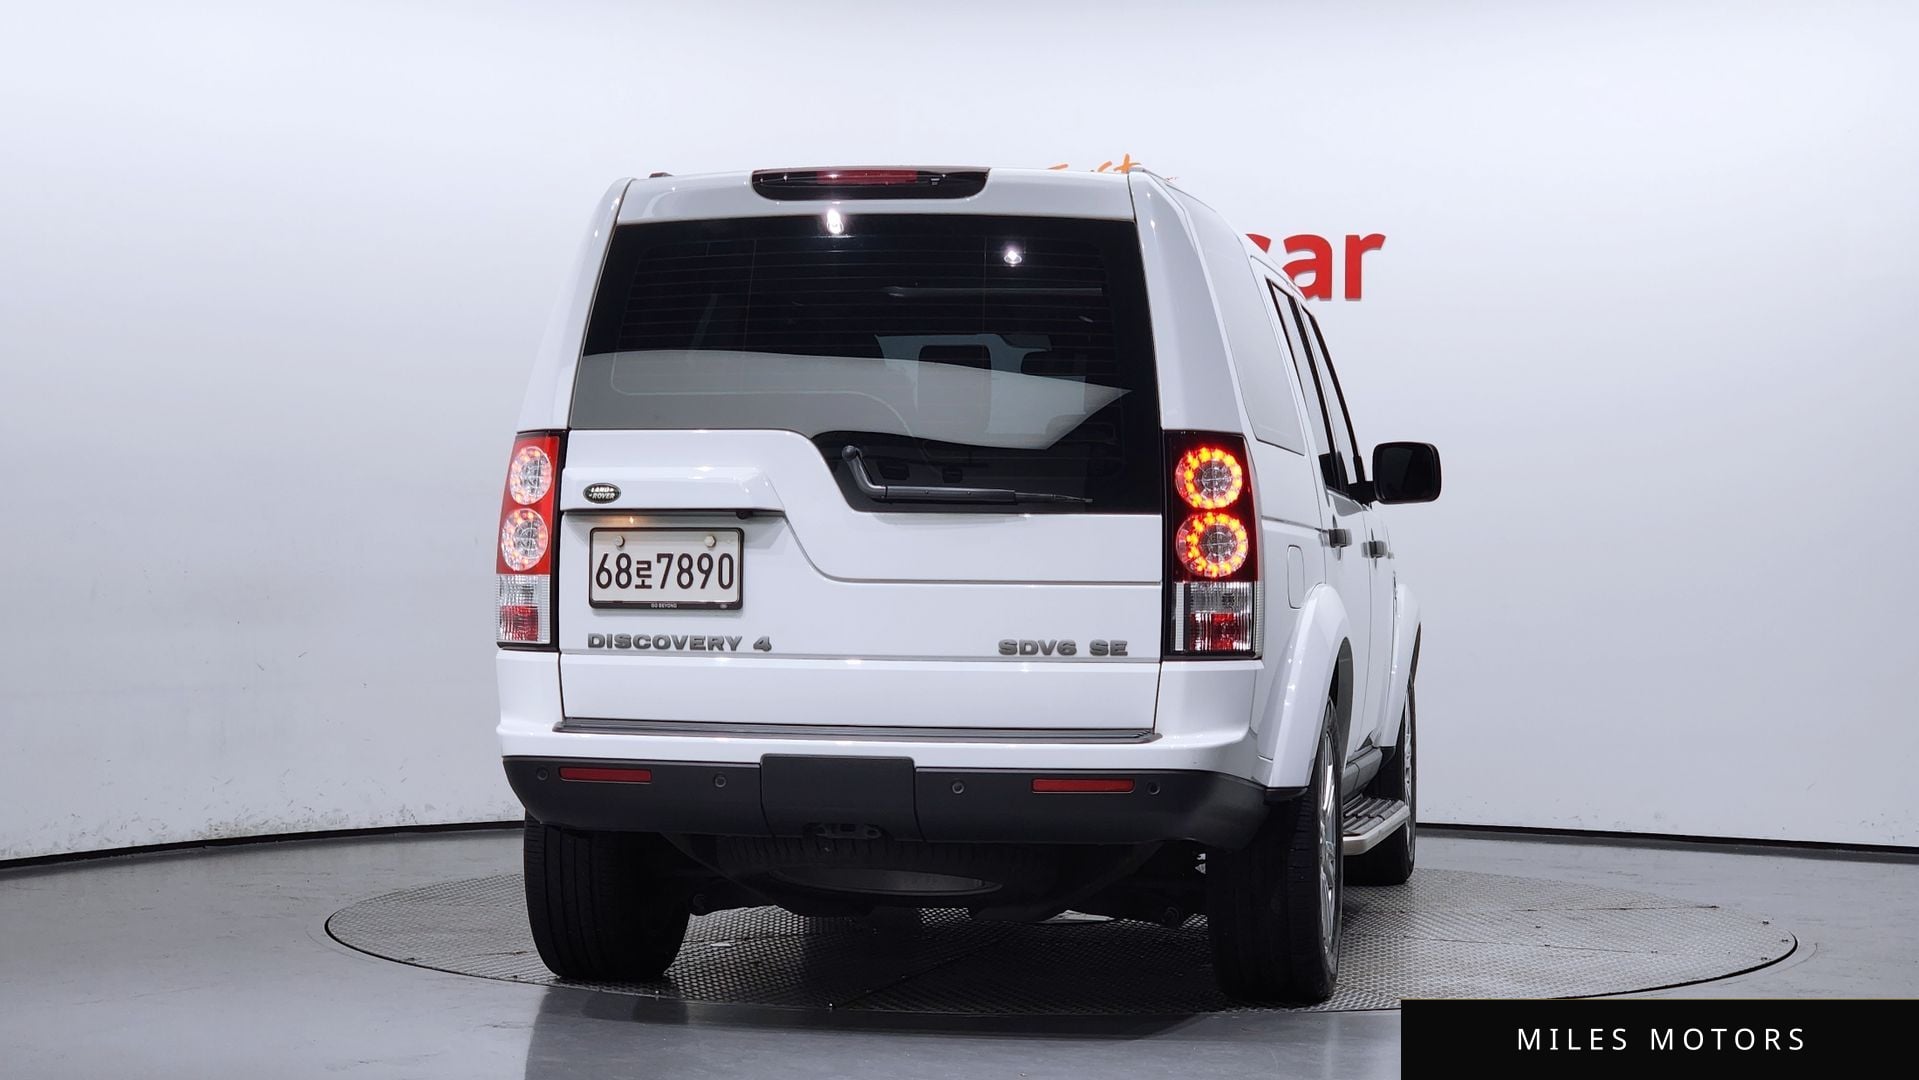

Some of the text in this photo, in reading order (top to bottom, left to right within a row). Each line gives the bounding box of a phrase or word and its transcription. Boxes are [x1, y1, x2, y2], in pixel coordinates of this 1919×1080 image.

[1246, 233, 1386, 301] ar
[595, 553, 734, 590] 68로7890
[587, 633, 773, 652] DISCOVERY 4
[998, 638, 1129, 656] SDV6 SE
